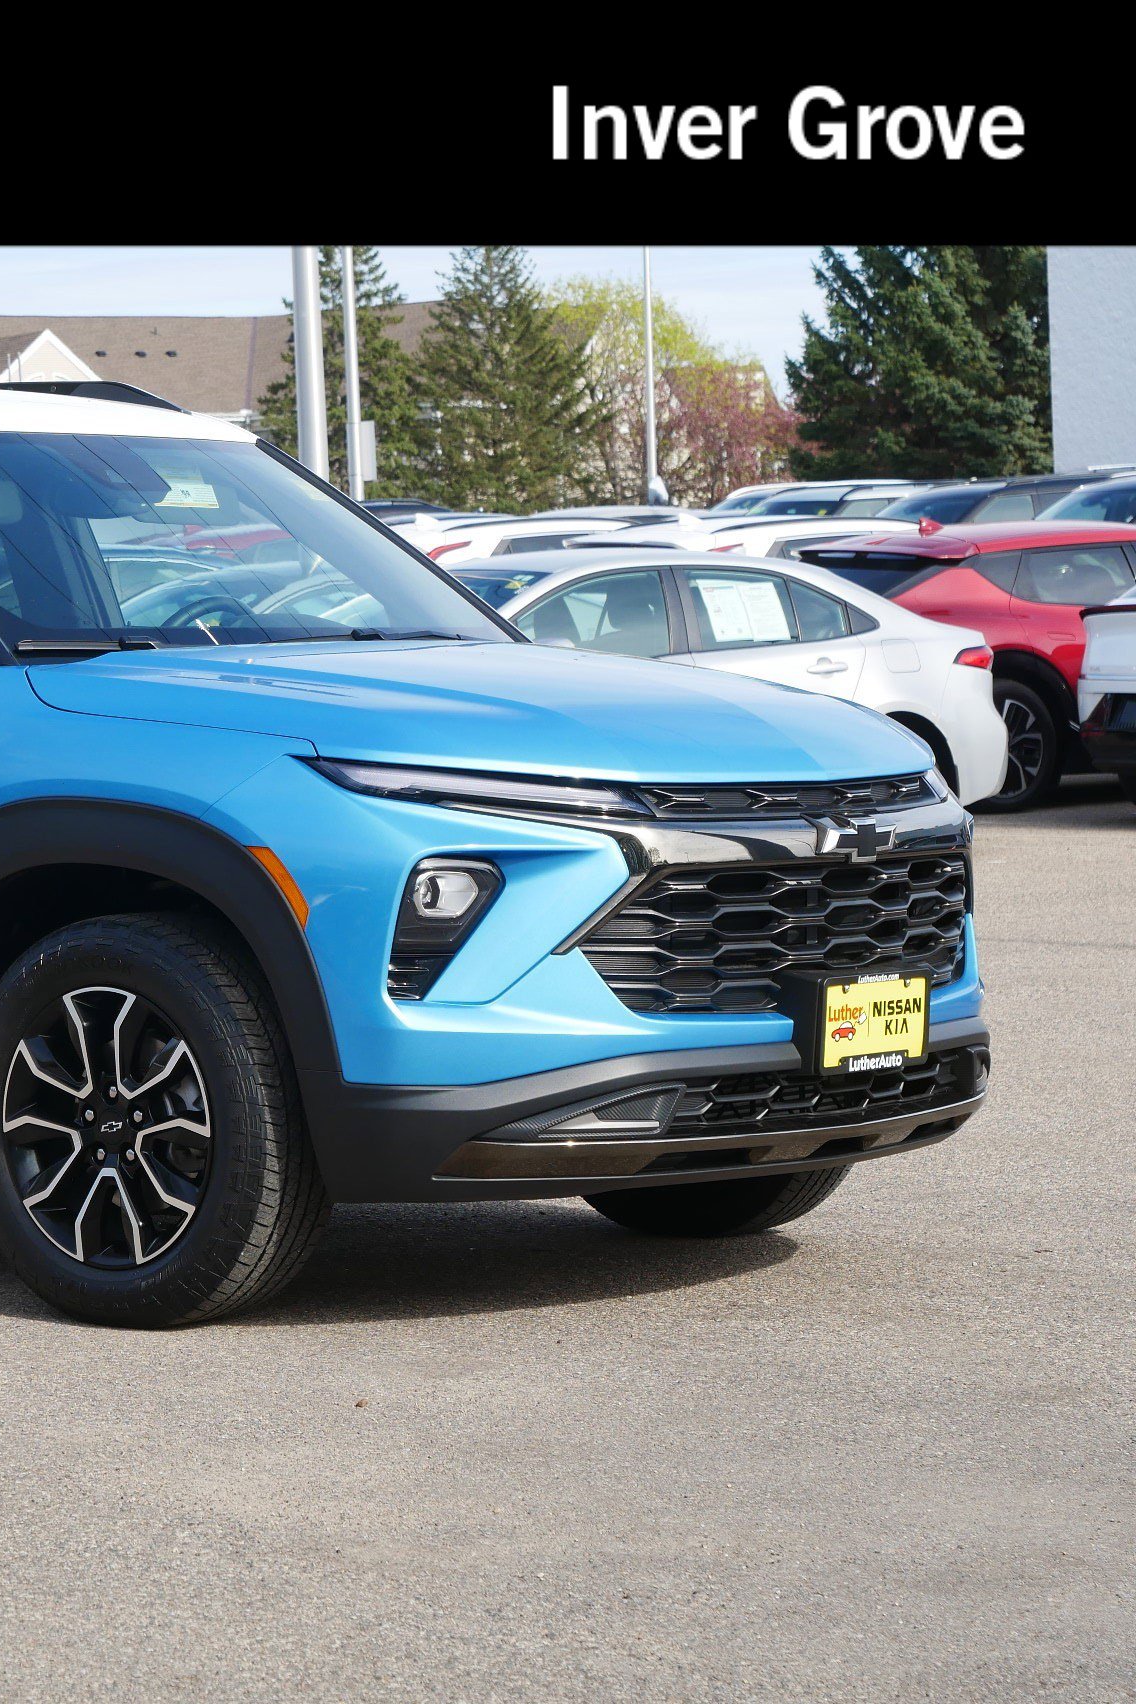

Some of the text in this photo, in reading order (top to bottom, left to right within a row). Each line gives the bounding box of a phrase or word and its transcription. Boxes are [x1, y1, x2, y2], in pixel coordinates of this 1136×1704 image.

[828, 1005, 864, 1022] Luther
[872, 997, 922, 1017] NISSAN
[884, 1018, 909, 1035] KIA
[849, 1053, 902, 1072] LutherAuto
